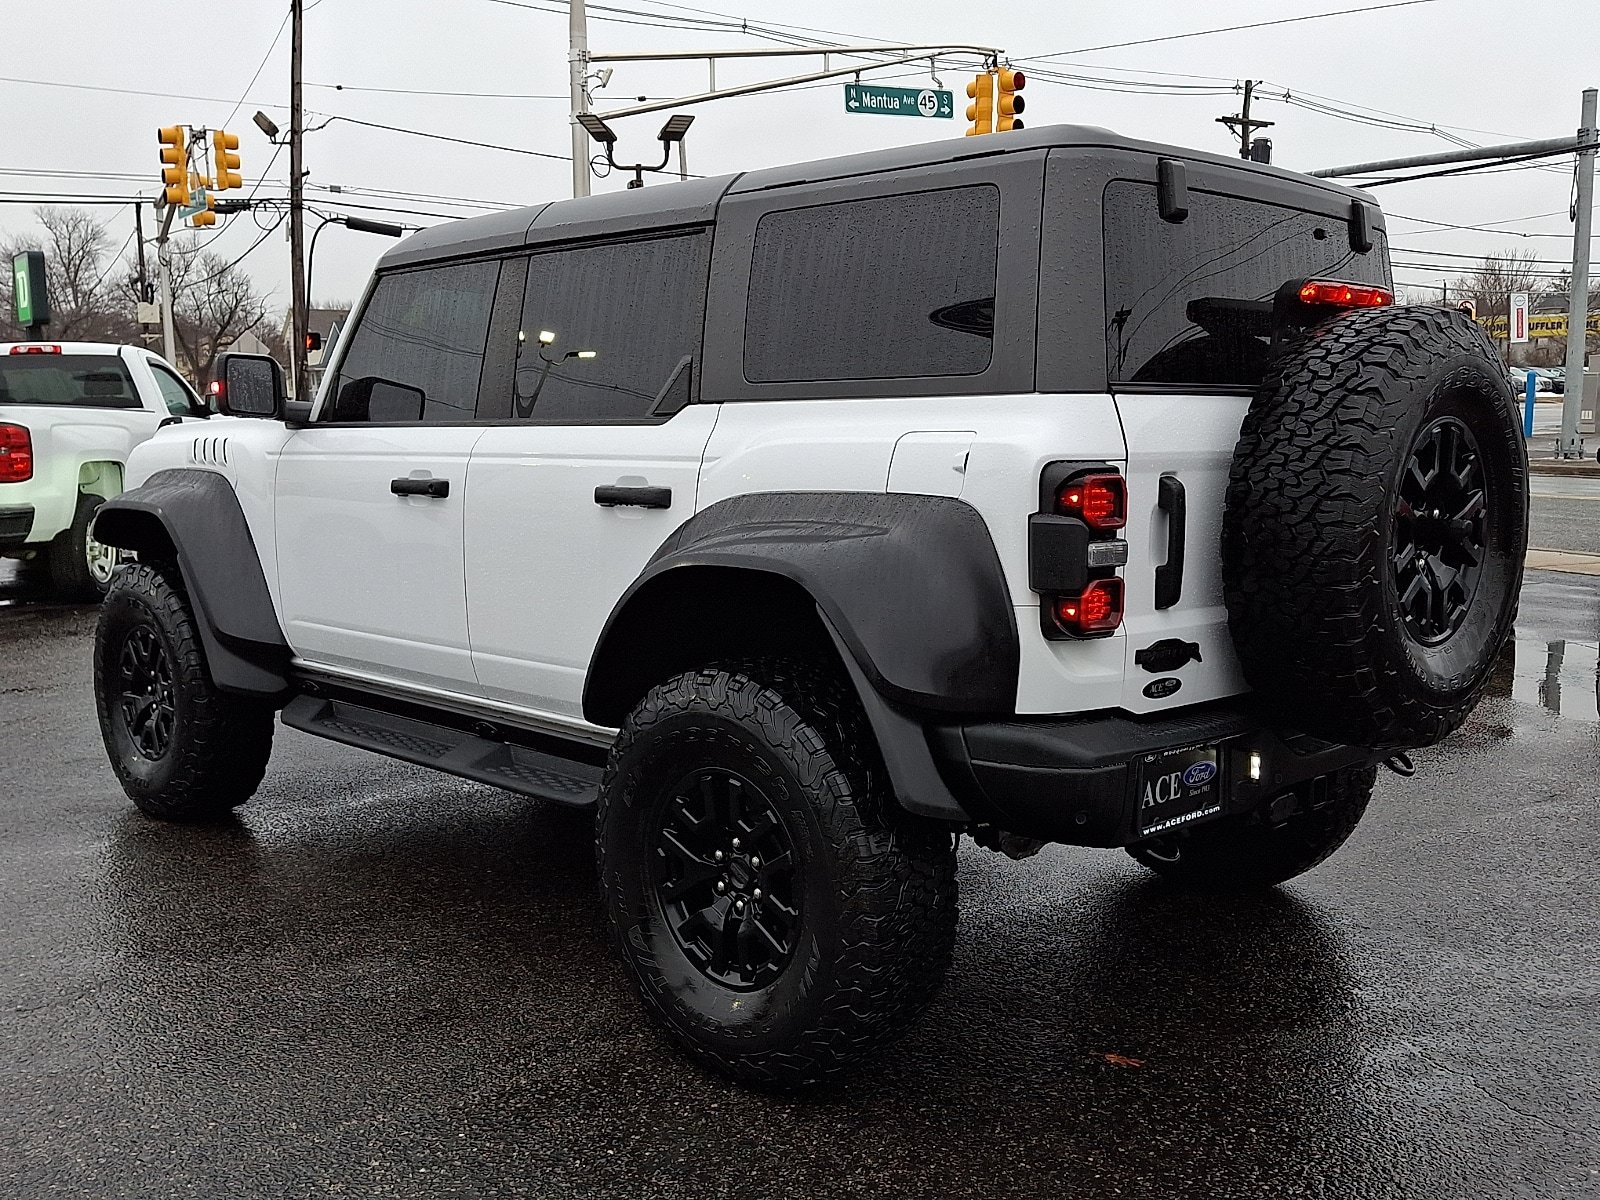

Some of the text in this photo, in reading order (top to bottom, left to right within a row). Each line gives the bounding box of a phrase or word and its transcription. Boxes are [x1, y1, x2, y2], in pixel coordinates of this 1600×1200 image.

[850, 87, 856, 99] N
[862, 91, 915, 109] Mantua Ave
[942, 95, 948, 105] S
[919, 95, 936, 110] 45
[1527, 320, 1563, 331] UFFLER
[1189, 765, 1211, 783] Ford
[1141, 771, 1182, 810] ACE
[1142, 805, 1221, 836] www.ACEFORD.com
